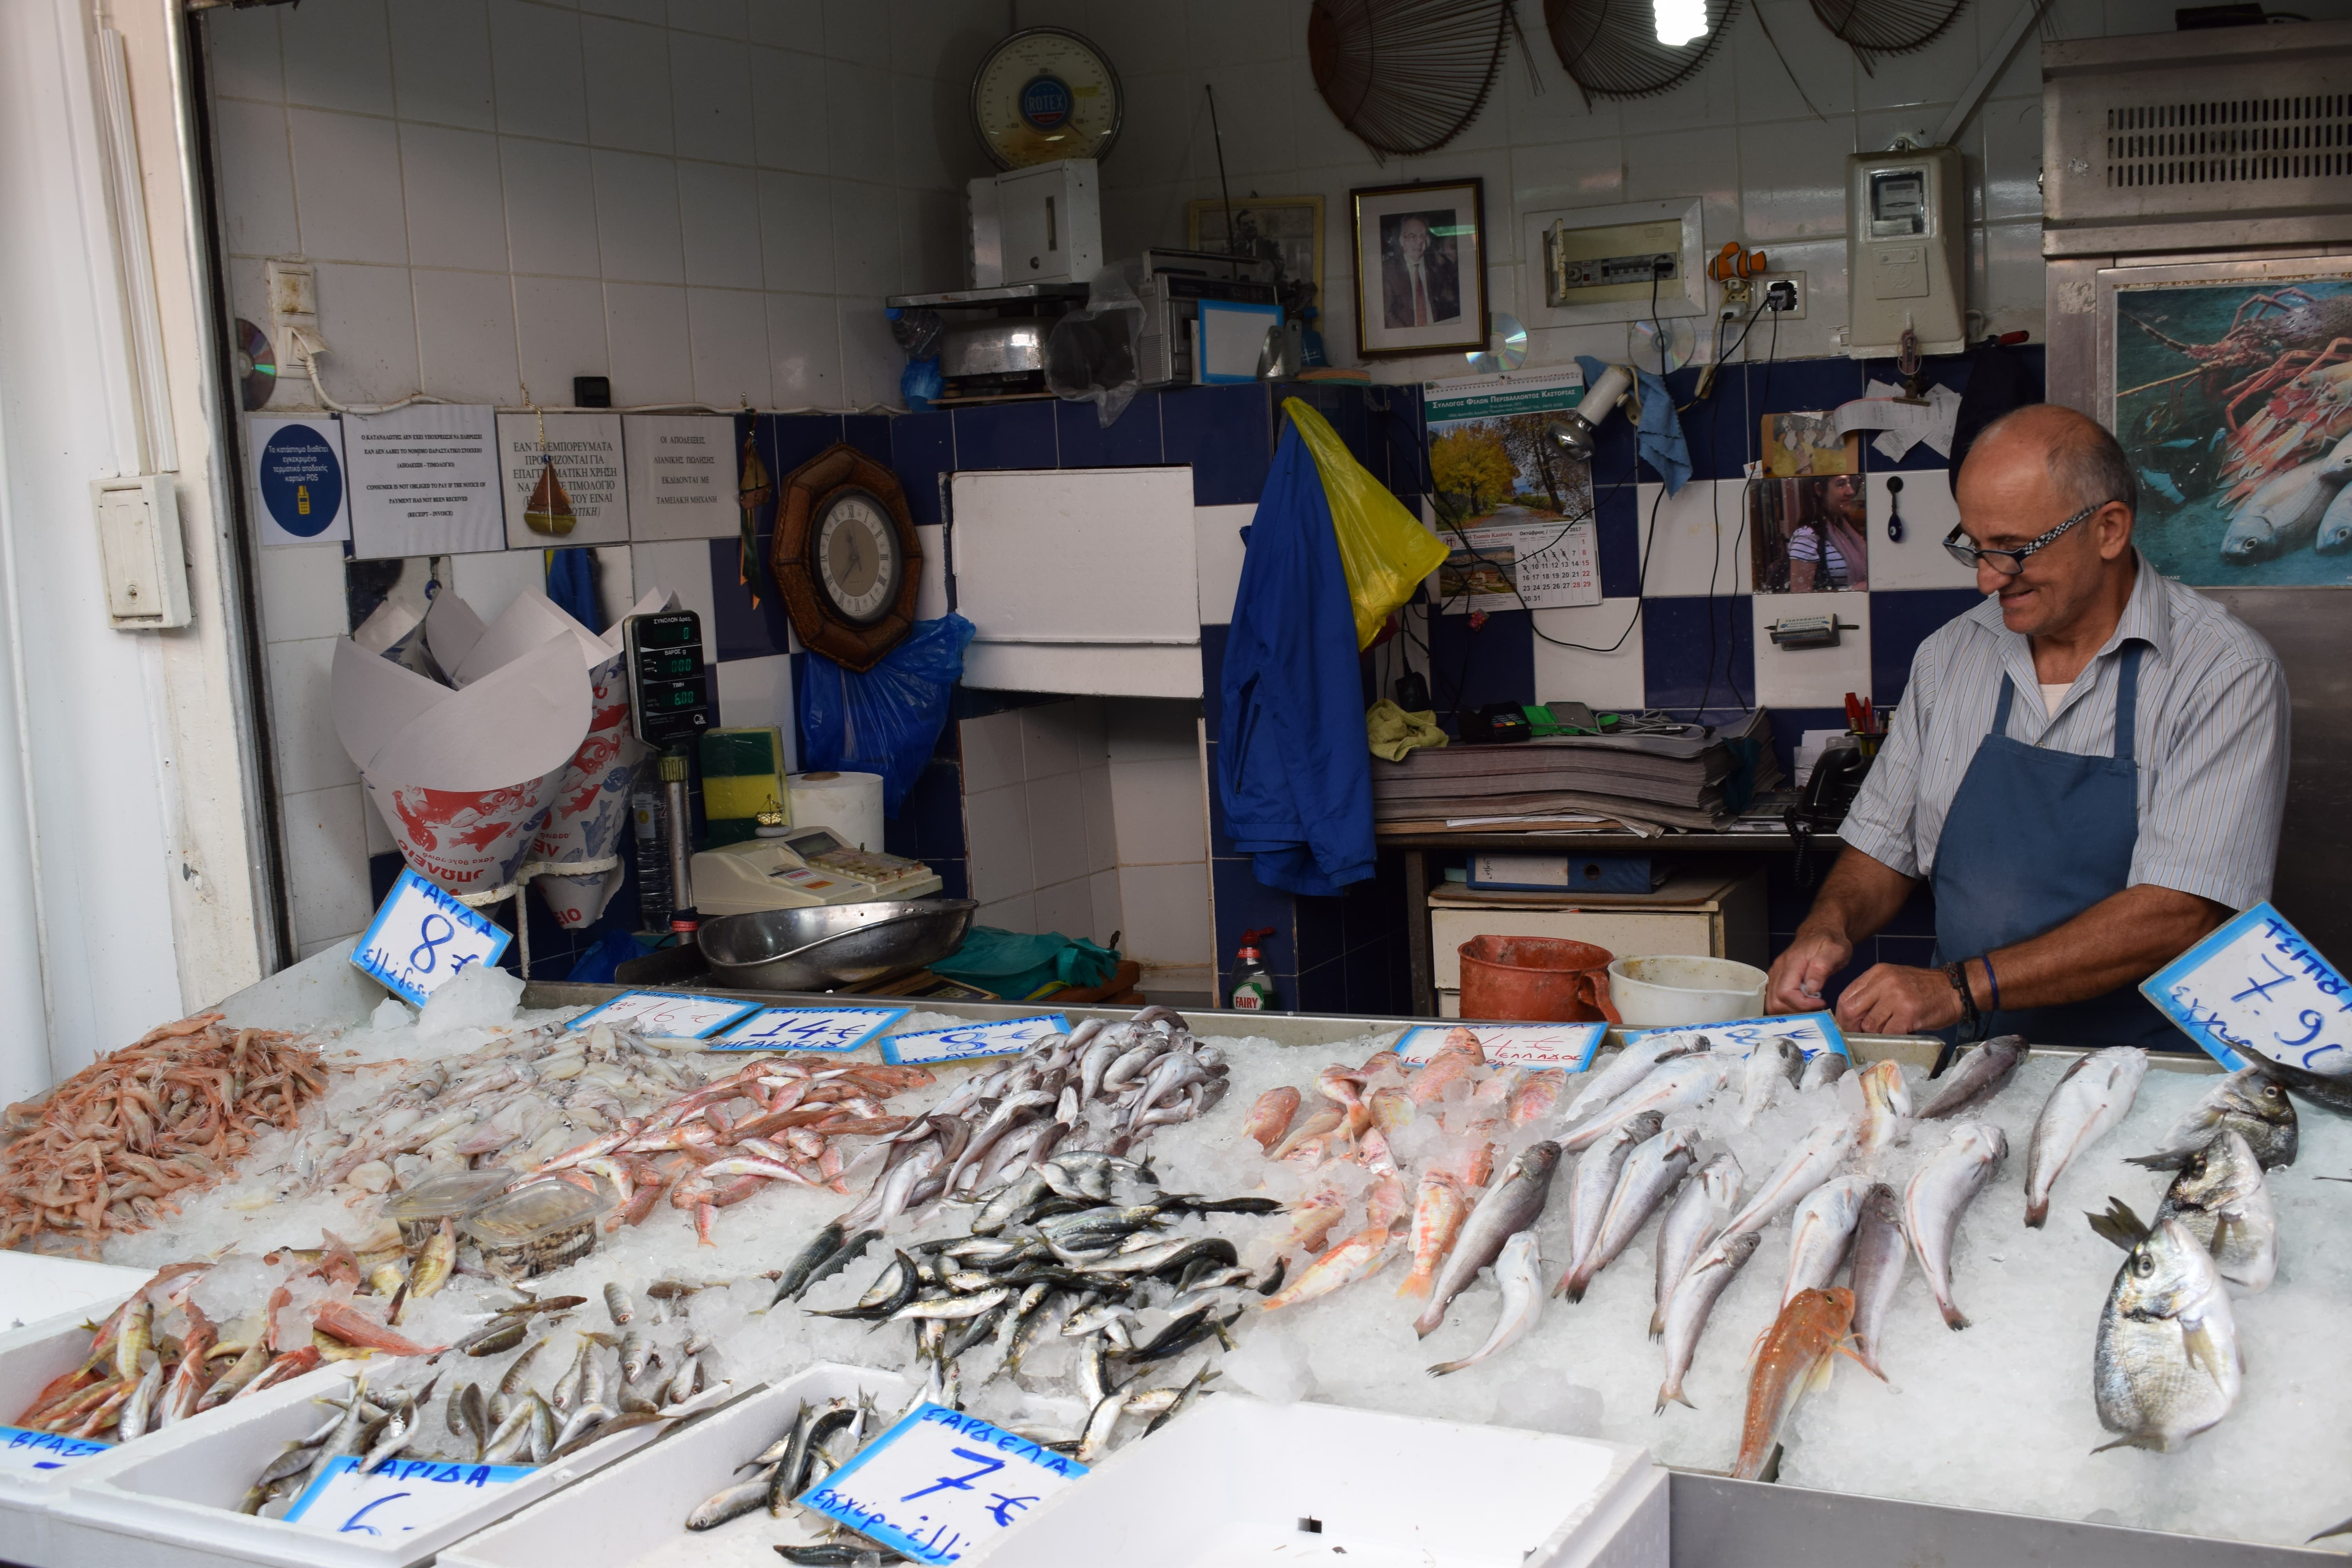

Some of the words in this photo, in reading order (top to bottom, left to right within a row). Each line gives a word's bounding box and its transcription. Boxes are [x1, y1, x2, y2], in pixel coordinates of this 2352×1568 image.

[1029, 94, 1063, 111] ROTEX
[277, 445, 306, 454] κατάστημα
[514, 442, 531, 451] ΕΑΝ
[548, 442, 613, 451] ΕΜΠΟΡΕΥΜΑΤΑ
[283, 455, 317, 464] εγκεκριμένο
[526, 456, 588, 465] ΠΡΟΡΙΖΟΝΤΑΙ
[590, 455, 604, 464] ΓΙΑ
[273, 465, 300, 473] τερματικό
[302, 464, 328, 472] αποδοχής
[514, 468, 587, 478] ΕΠΑΓΓΜΑΤΙΚΗ
[590, 468, 617, 477] ΧΡΗΣΗ
[285, 474, 305, 483] καρτών
[518, 483, 530, 492] ΝΑ
[569, 481, 615, 490] ΤΙΜΟΛΟΓΙΟ
[571, 494, 588, 503] ΤΟΥ
[590, 494, 613, 503] ΕΙΝΑΙ
[683, 627, 689, 639] 0
[412, 876, 492, 937] ΓΑΡΙΔΑ
[410, 914, 455, 974] 8
[1236, 996, 1258, 1009] FAIRY
[637, 1001, 699, 1022] 16
[939, 1032, 987, 1051] 8
[902, 1044, 1031, 1064] ΗΡΑΚΛΕΙ
[901, 1447, 1005, 1502] 7
[985, 1493, 1040, 1527] €
